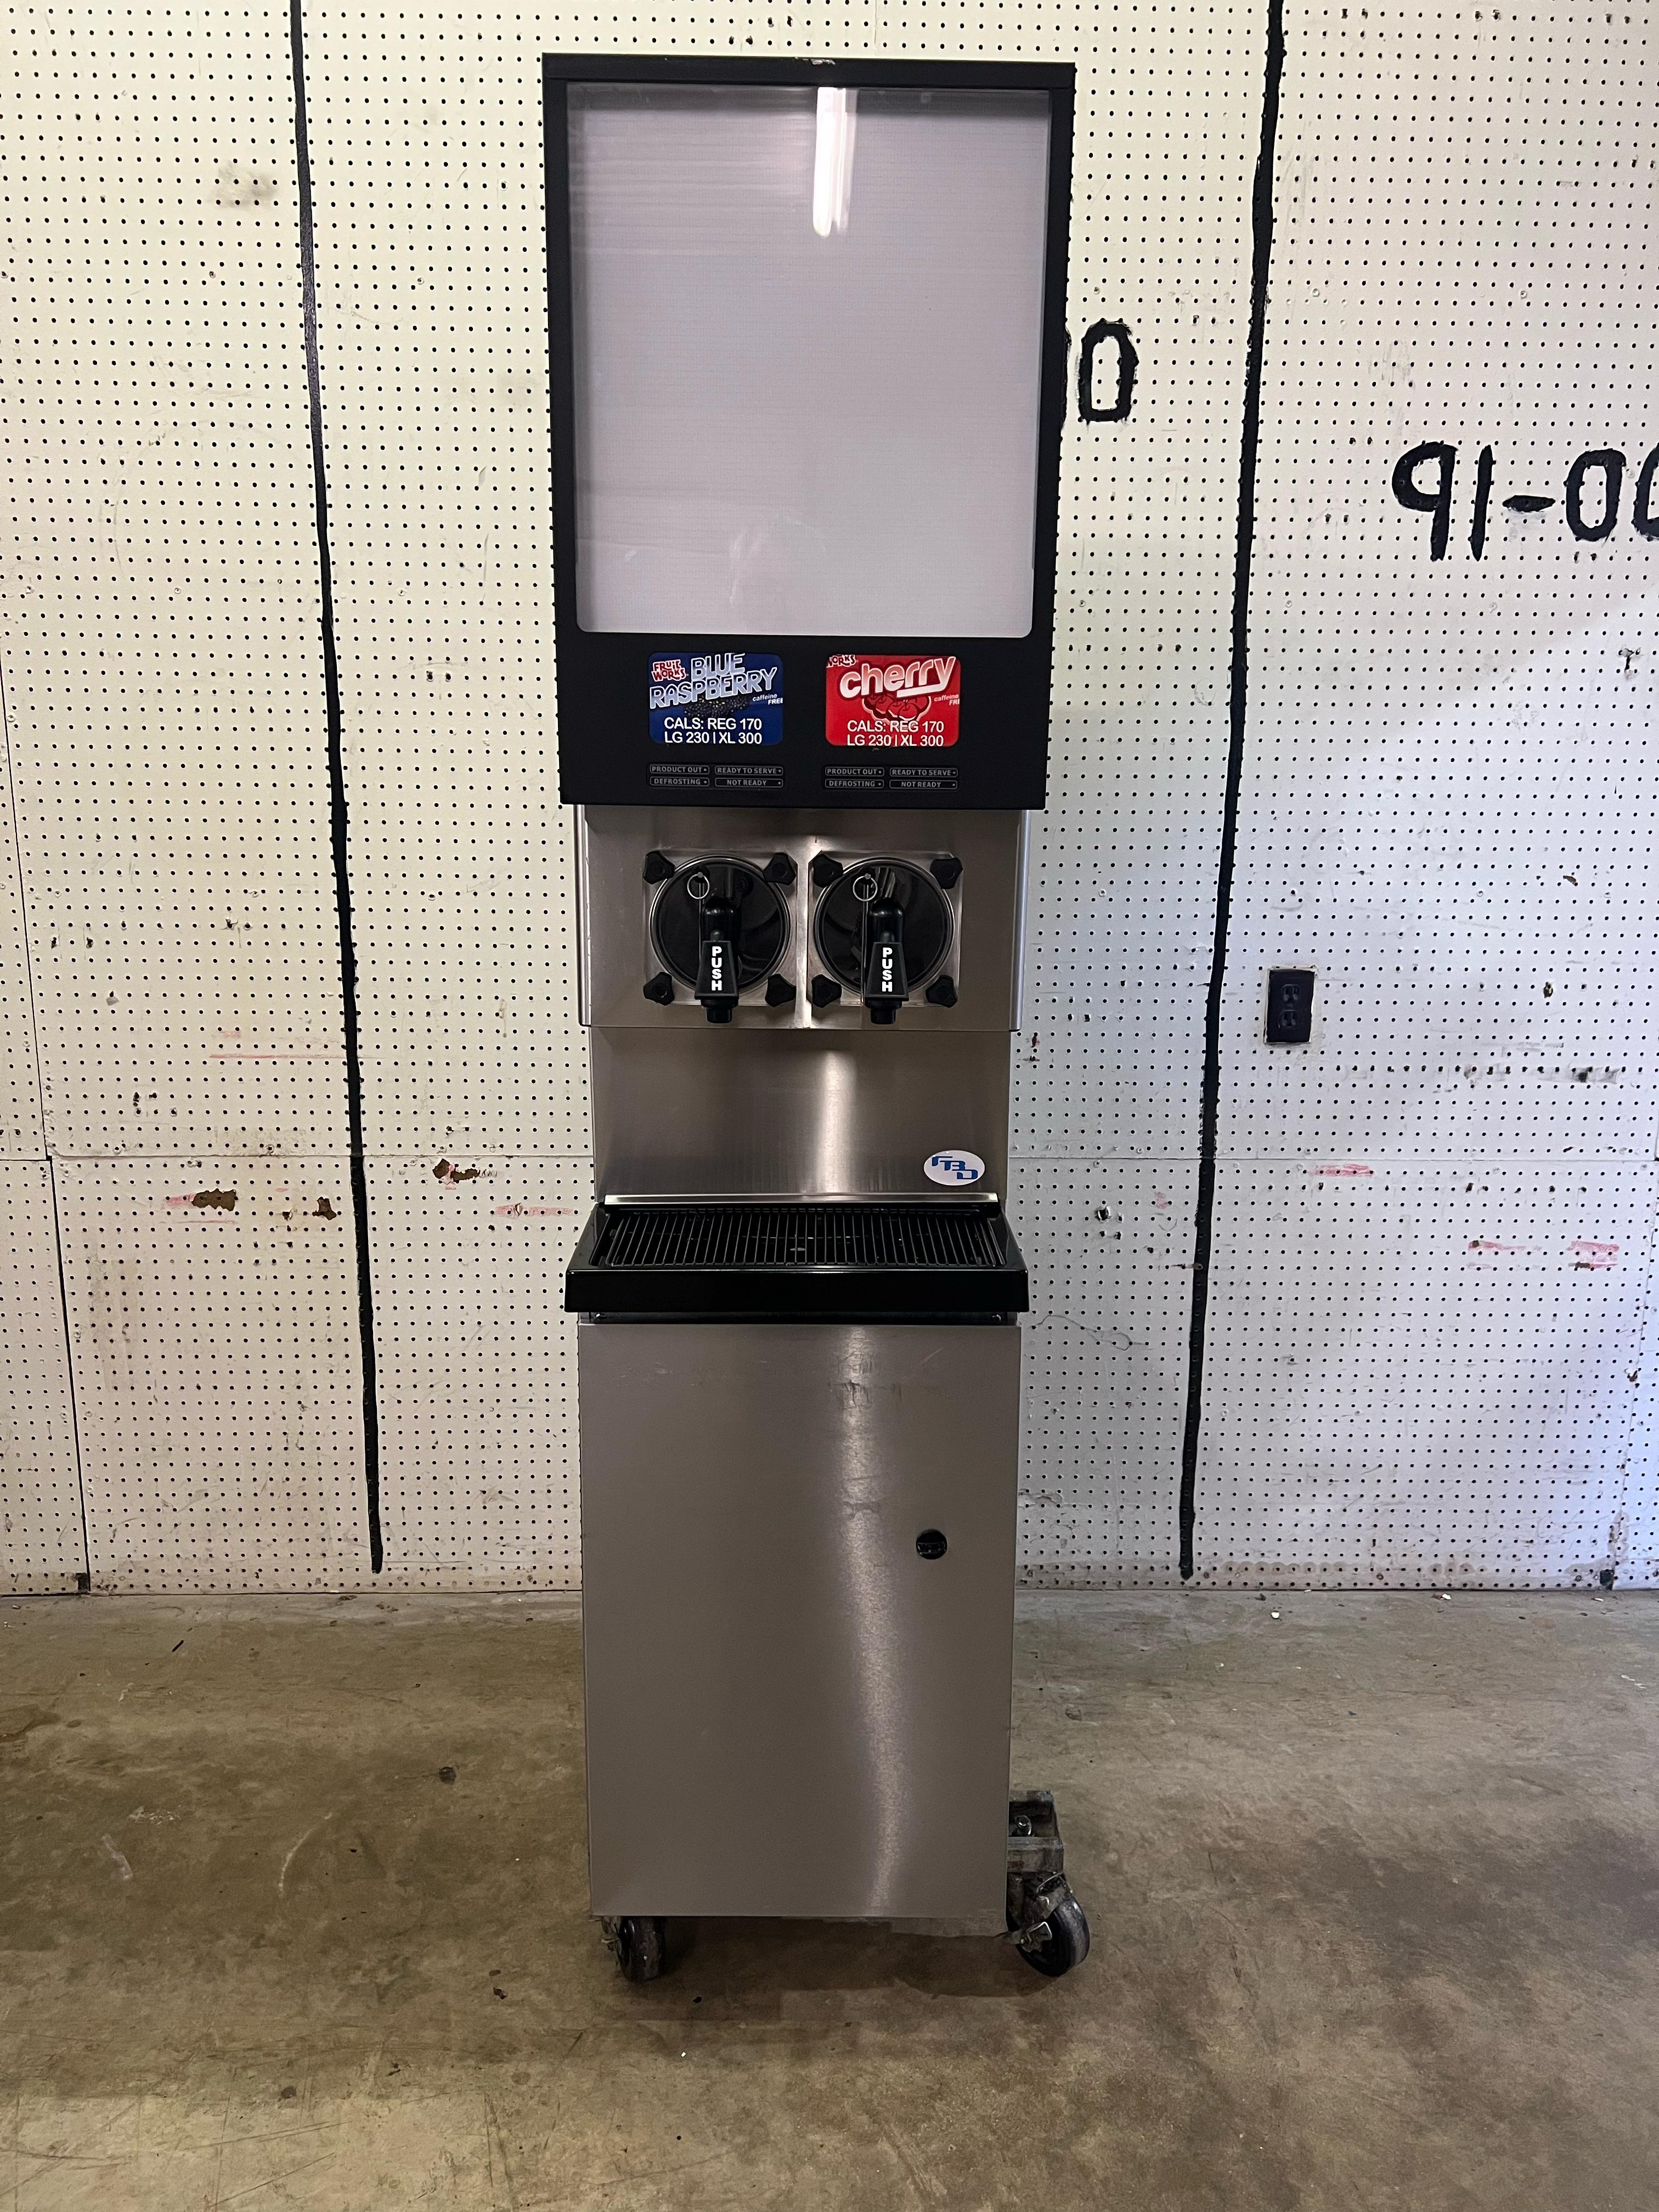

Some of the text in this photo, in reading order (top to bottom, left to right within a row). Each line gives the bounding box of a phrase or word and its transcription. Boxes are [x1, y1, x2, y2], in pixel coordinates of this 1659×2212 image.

[691, 653, 745, 680] BLUE
[652, 668, 686, 681] WORKS
[840, 656, 956, 698] cherry
[650, 667, 777, 709] RASPBERRY
[752, 693, 778, 702] caffeine
[664, 717, 762, 730] CALS: REG 170
[847, 720, 944, 733] CALS: REG 170
[664, 731, 683, 743] LG
[686, 731, 709, 744] 230
[719, 732, 736, 744] XL
[738, 732, 762, 744] 300
[847, 735, 865, 747] LG
[868, 735, 892, 747] 230
[900, 735, 917, 747] XL
[920, 735, 944, 747] 300
[711, 946, 723, 991] PUSH
[882, 947, 893, 992] PUSH
